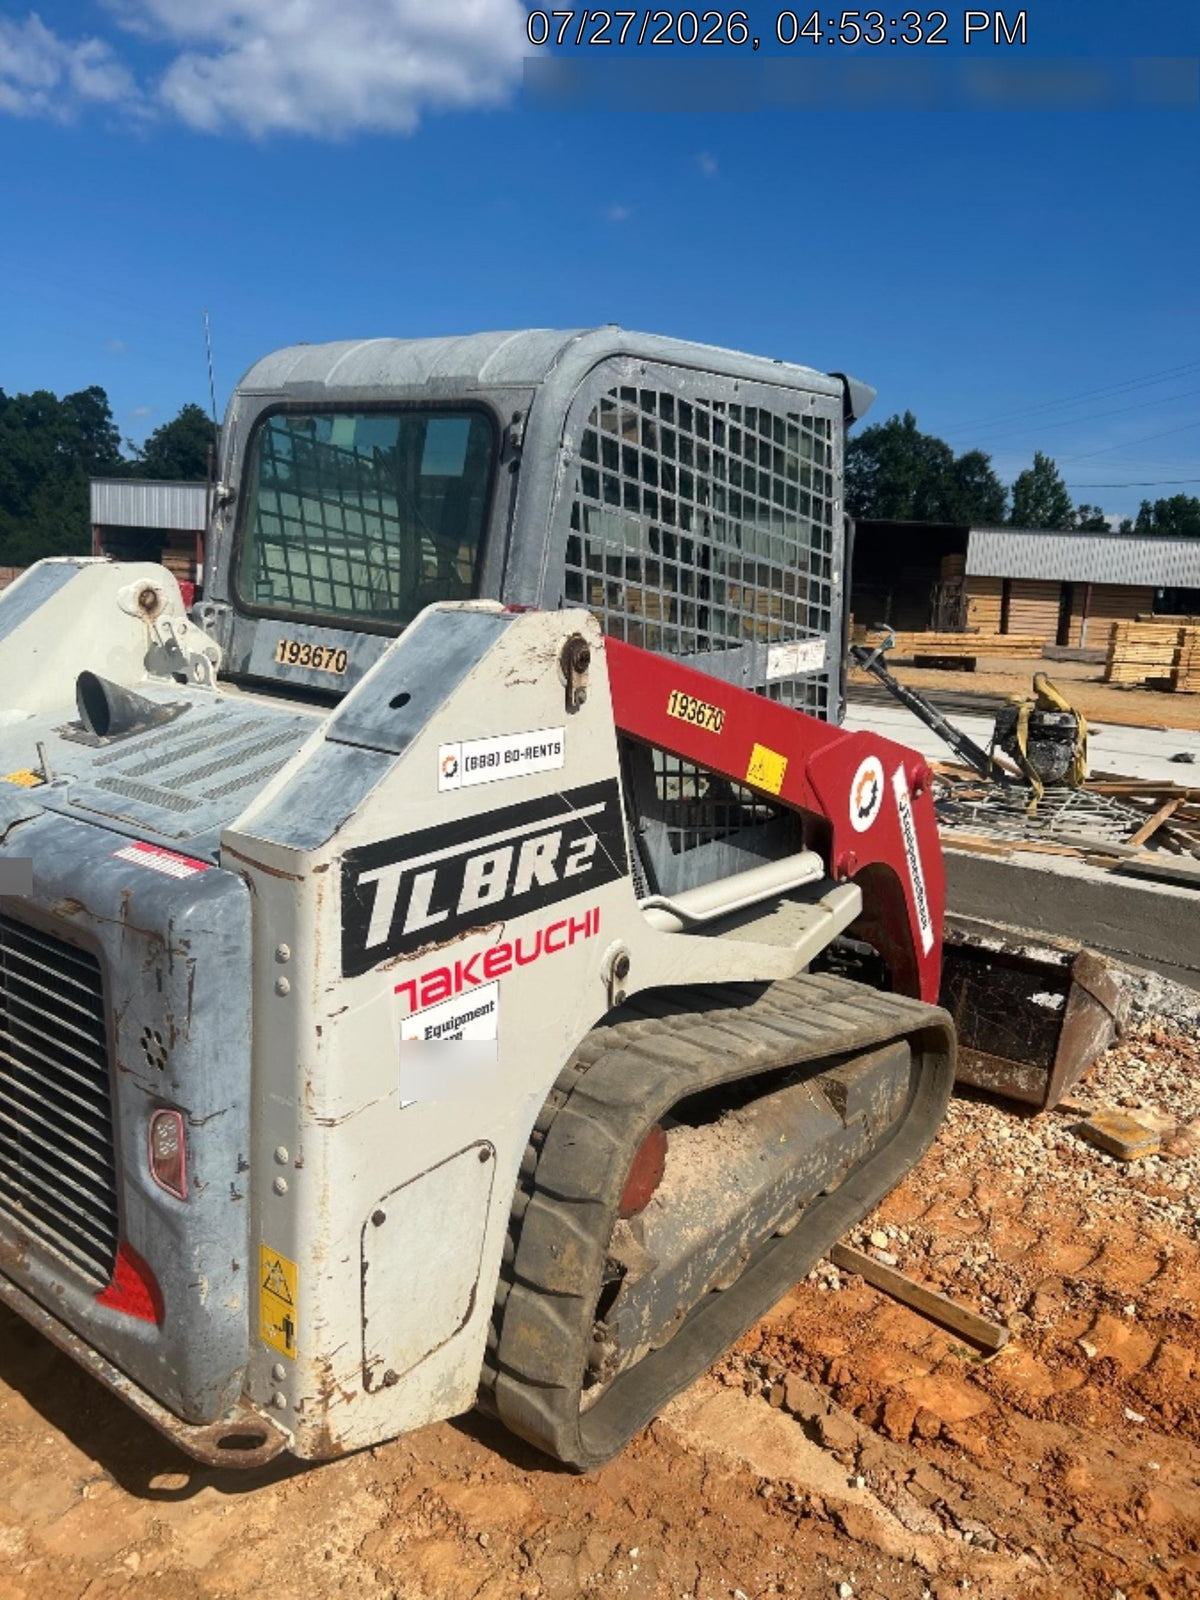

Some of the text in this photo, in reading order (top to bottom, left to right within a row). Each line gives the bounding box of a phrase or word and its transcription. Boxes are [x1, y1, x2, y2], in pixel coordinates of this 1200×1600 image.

[279, 640, 348, 673] 193670
[671, 692, 724, 732] 193670
[424, 1000, 495, 1040] Equipment
